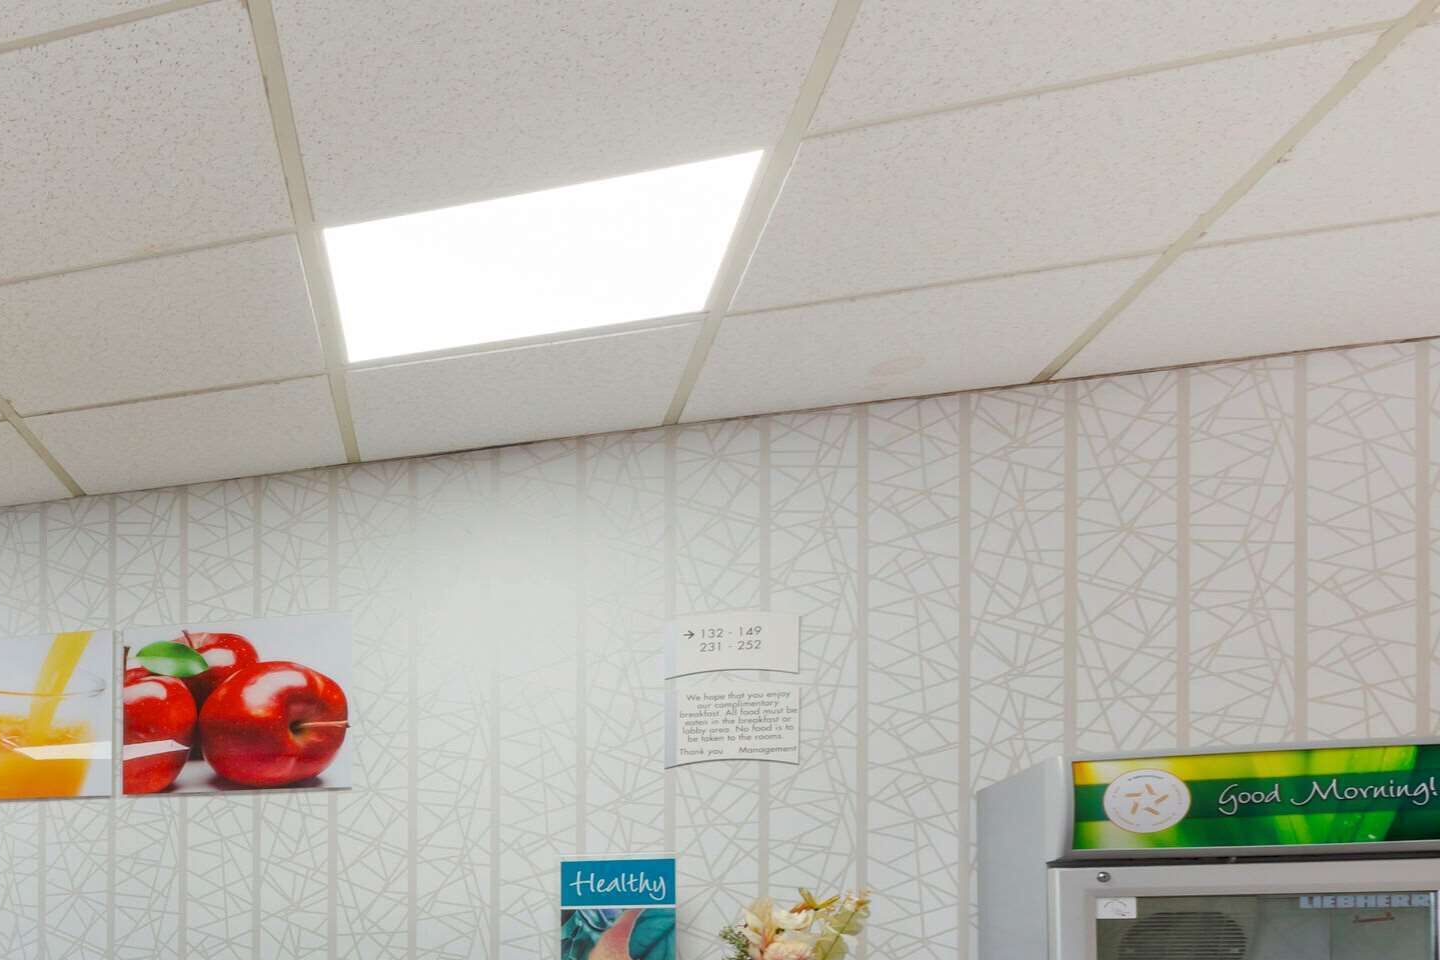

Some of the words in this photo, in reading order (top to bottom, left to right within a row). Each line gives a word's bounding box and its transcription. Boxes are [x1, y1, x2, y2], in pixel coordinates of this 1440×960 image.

[701, 627, 724, 639] 132
[738, 625, 762, 637] 149
[699, 641, 721, 653] 231
[737, 639, 762, 651] 252
[704, 693, 725, 701] hope
[714, 700, 778, 710] complimentary
[738, 746, 797, 755] Management
[1218, 782, 1281, 816] Good
[1290, 775, 1438, 807] Morning!
[568, 870, 667, 901] Healthy
